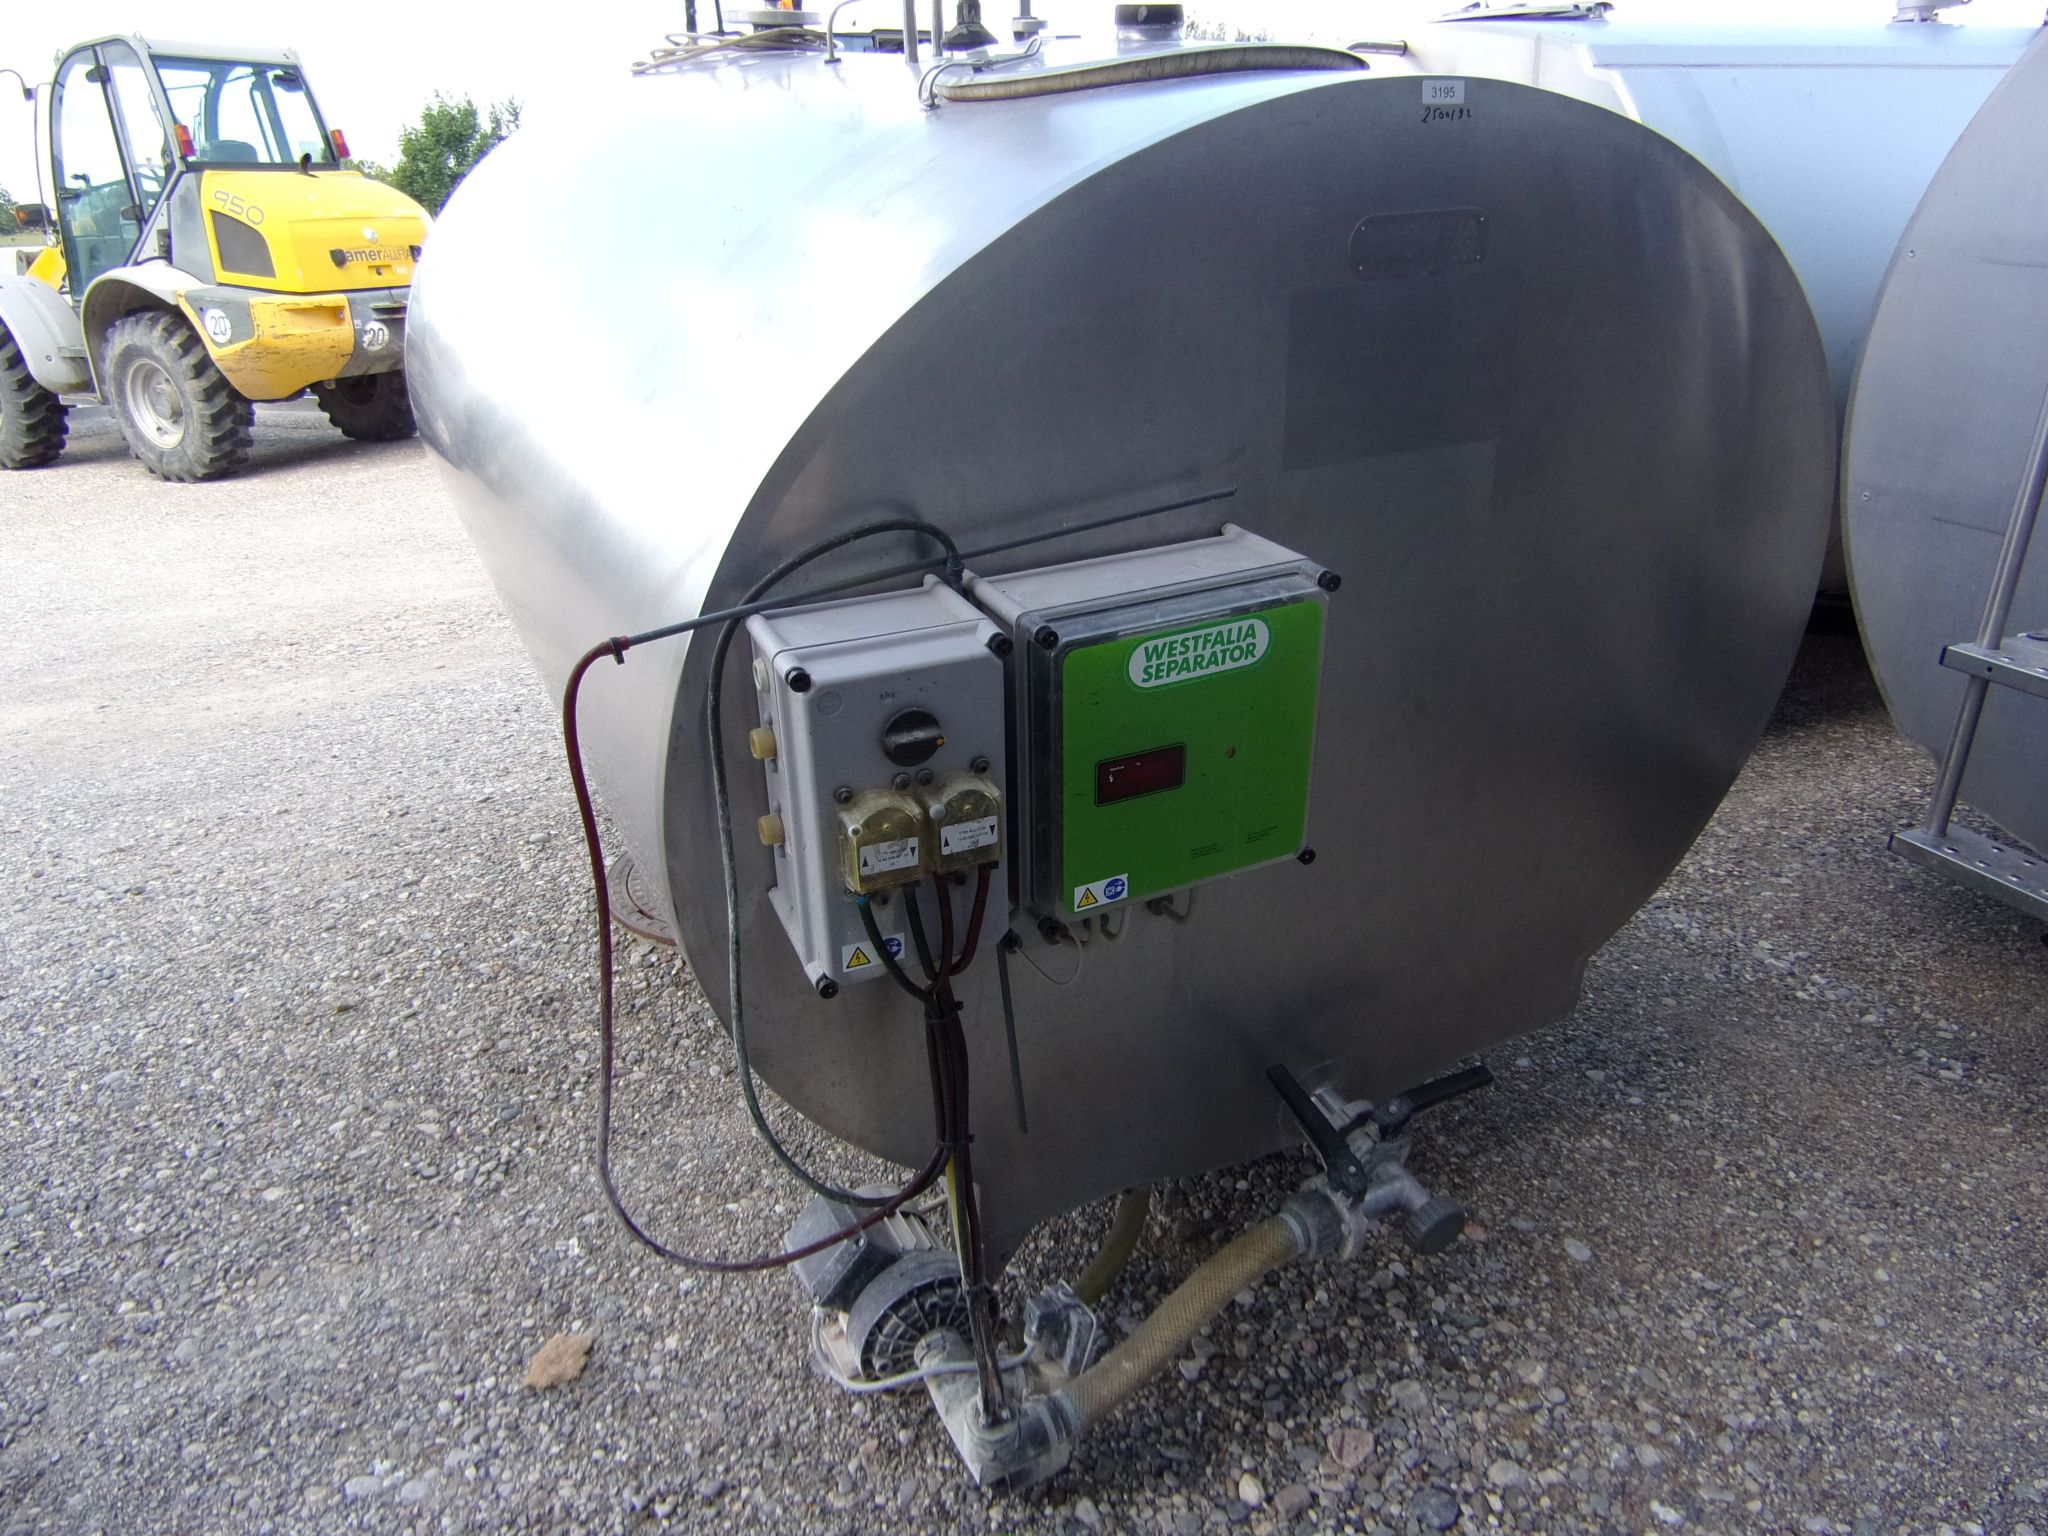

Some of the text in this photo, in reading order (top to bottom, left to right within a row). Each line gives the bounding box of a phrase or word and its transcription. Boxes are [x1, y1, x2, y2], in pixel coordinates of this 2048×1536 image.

[1431, 86, 1456, 99] 3195
[214, 190, 265, 226] 950
[210, 315, 227, 336] 20
[367, 327, 385, 347] 20
[1143, 623, 1257, 663] WESTFALIA
[1141, 642, 1257, 683] SEPARATOR
